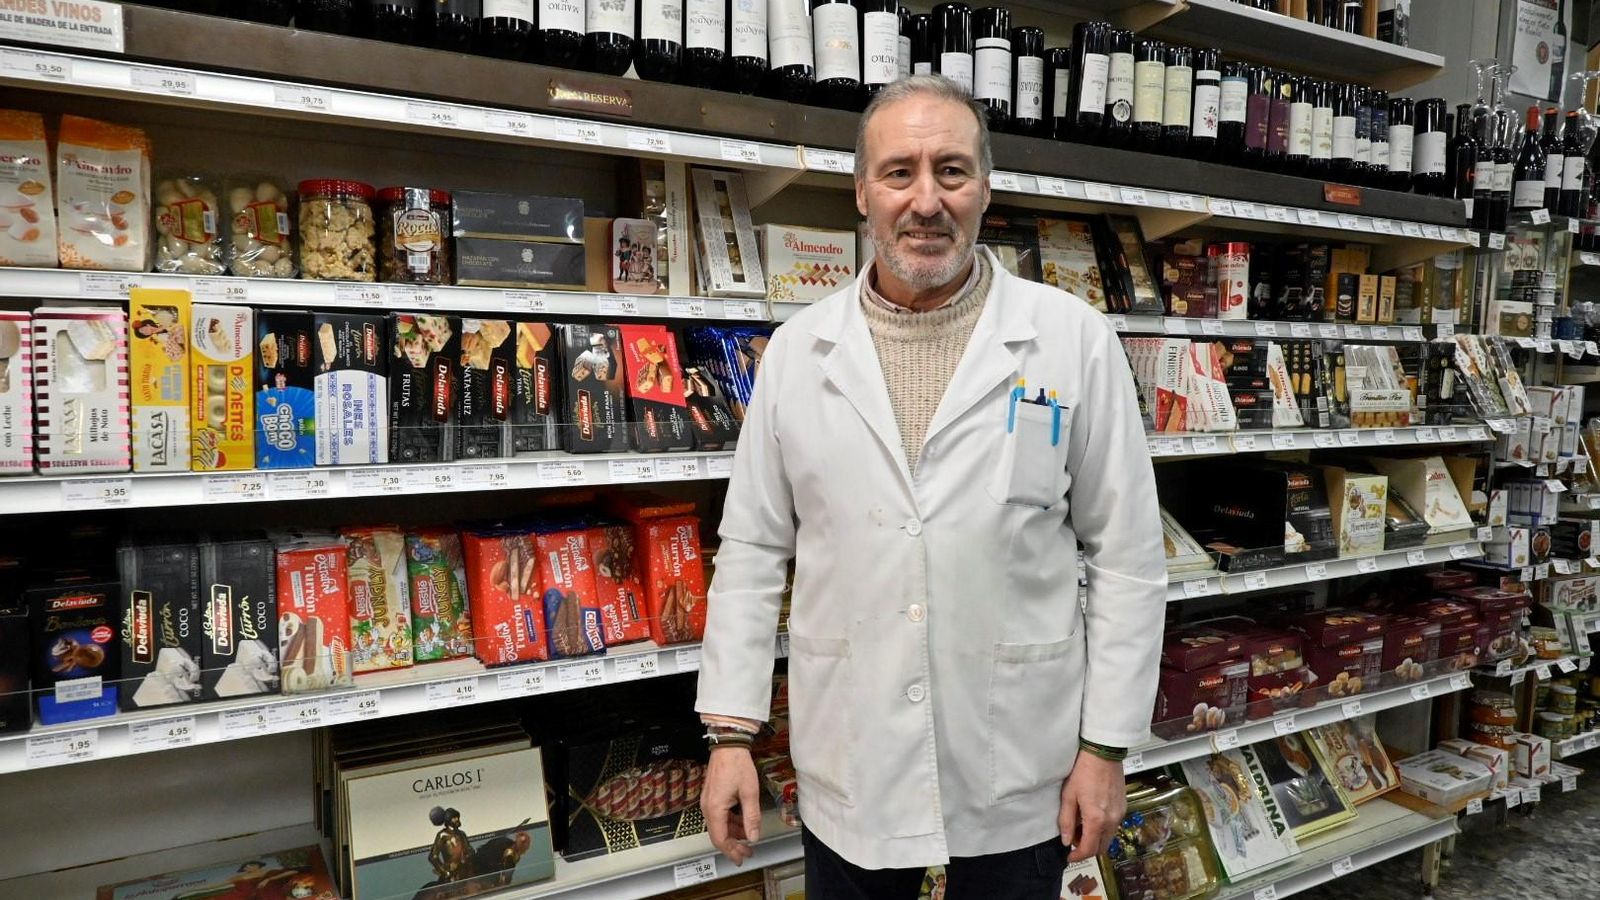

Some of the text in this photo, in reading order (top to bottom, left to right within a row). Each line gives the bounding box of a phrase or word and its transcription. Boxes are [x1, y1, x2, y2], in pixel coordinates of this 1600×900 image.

[51, 0, 102, 22] VINOS
[14, 15, 24, 23] DE
[25, 16, 56, 28] MADERA
[57, 20, 67, 29] DE
[69, 22, 78, 30] LA
[79, 23, 112, 36] ENTRADA
[35, 64, 62, 73] 53,50
[161, 79, 187, 89] 29,95
[300, 96, 324, 105] 39,75
[583, 91, 630, 106] RESERVA
[397, 220, 438, 236] Rocas
[791, 241, 843, 255] Almendro
[361, 292, 380, 300] 11,50
[414, 294, 433, 302] 10,95
[233, 319, 242, 358] Almendro
[402, 373, 411, 407] FRUTAS
[436, 364, 448, 416] Delaviuda
[462, 366, 472, 416] NATA-NUEZ
[495, 364, 505, 414] Delaviuda
[537, 364, 547, 410] Delaviuda
[4, 404, 12, 432] Leche
[90, 408, 98, 442] Milhojas
[343, 383, 354, 446] ROSALES
[353, 399, 363, 429] INES
[582, 395, 590, 435] Delaviuda
[101, 432, 108, 442] de
[151, 411, 167, 466] LACASA
[52, 459, 88, 468] MAESTROS
[242, 482, 262, 491] 7,25
[306, 480, 324, 488] 7,30
[383, 477, 399, 486] 7,30
[435, 475, 451, 483] 6,95
[489, 473, 505, 481] 7,95
[104, 488, 126, 497] 3,95
[560, 544, 573, 588] Turrón
[671, 536, 681, 577] Turrón
[304, 564, 315, 612] Turrón
[370, 569, 389, 627] JUNGLY
[419, 580, 430, 614] Nestlé
[434, 567, 450, 621] JUNGLY
[52, 596, 97, 609] Delaviuda
[356, 585, 365, 617] Nestlé
[617, 587, 630, 628] Turrón
[137, 600, 148, 655] Delaviuda
[180, 608, 189, 638] COCO
[218, 593, 228, 646] Delaviuda
[238, 595, 258, 640] turrón
[257, 601, 267, 630] COCO
[514, 604, 525, 649] Turrón
[585, 611, 602, 650] CRUNCH
[456, 686, 472, 694] 4,10
[525, 677, 541, 685] 4,15
[300, 708, 319, 717] 4,15
[359, 700, 376, 709] 4,95
[168, 727, 188, 737] 4,95
[68, 740, 91, 750] 1,95
[412, 771, 473, 794] CARLOS
[695, 863, 711, 873] 16,50
